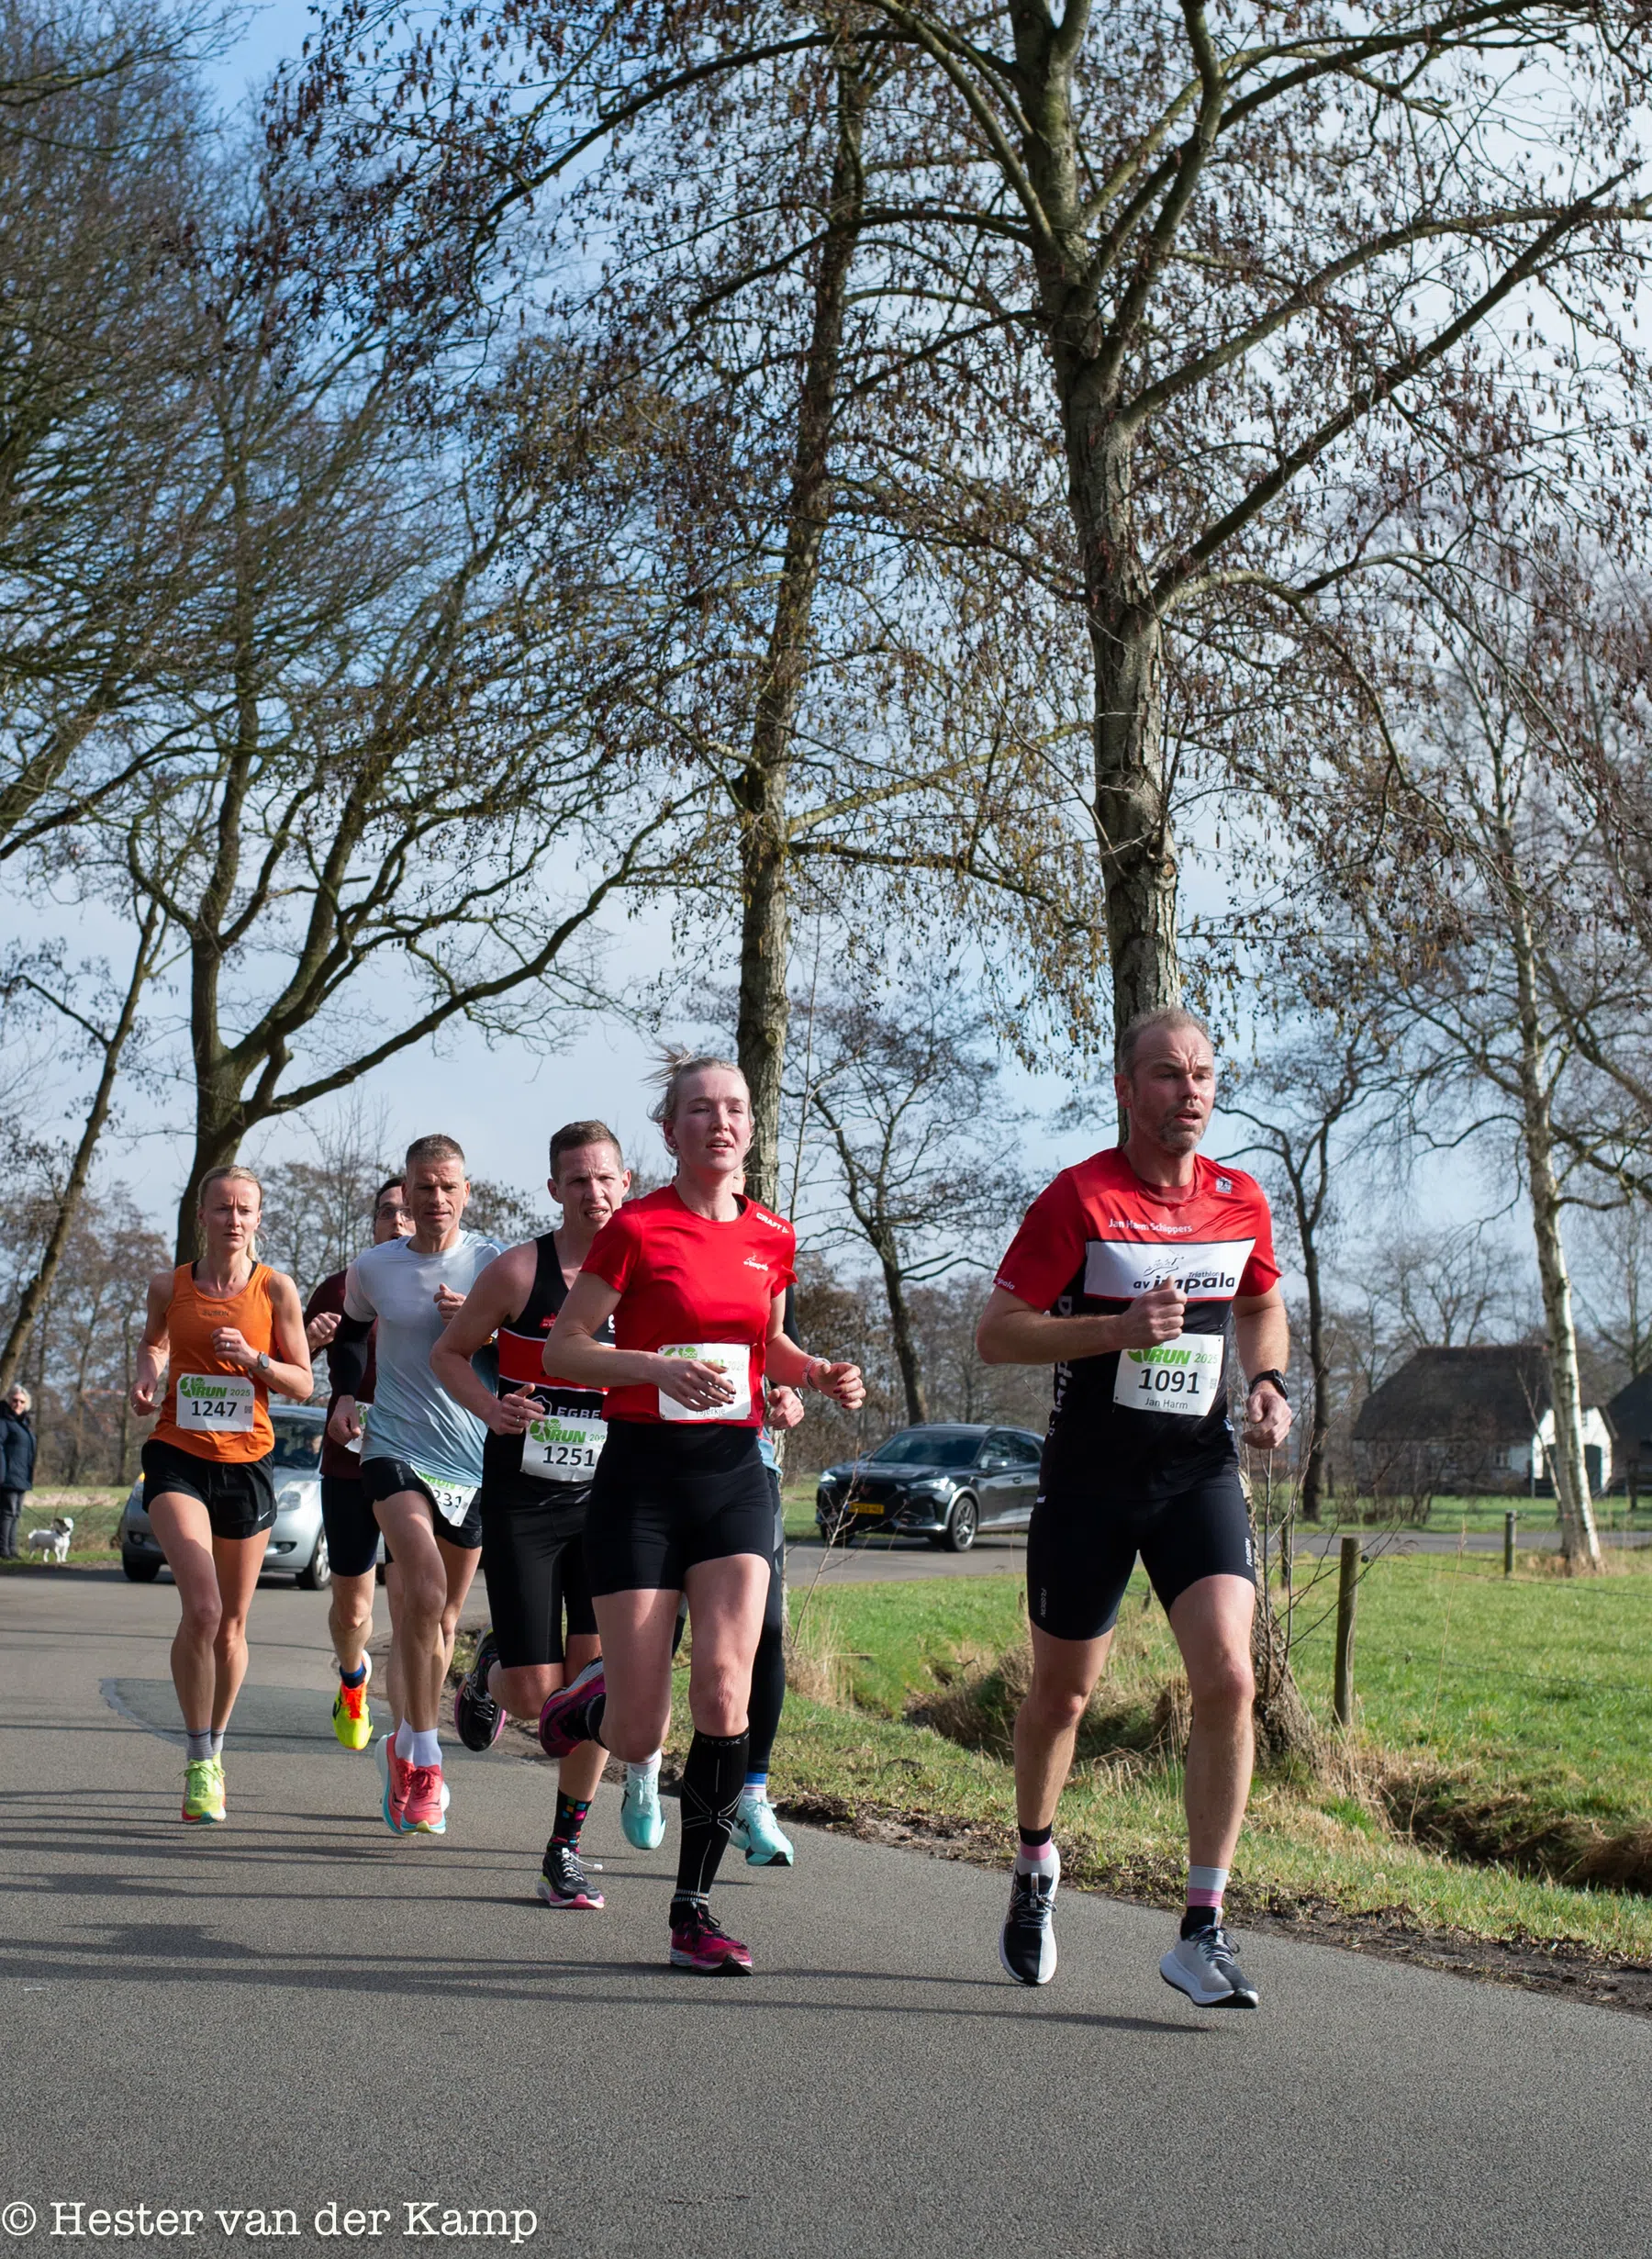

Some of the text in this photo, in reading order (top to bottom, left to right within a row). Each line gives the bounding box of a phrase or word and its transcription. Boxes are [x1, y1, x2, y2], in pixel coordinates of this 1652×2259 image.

[756, 1212, 782, 1230] CRAFT
[1109, 1218, 1124, 1228] Jan
[1150, 1222, 1192, 1235] Schippers
[1133, 1280, 1150, 1289] av
[1194, 1353, 1218, 1364] 2025
[1138, 1368, 1200, 1394] 1091
[195, 1386, 228, 1396] RUN
[191, 1400, 238, 1417] 1247
[1144, 1397, 1189, 1409] Jan Harm
[550, 1429, 586, 1443] RUN
[542, 1446, 596, 1467] 1251
[1245, 1538, 1254, 1567] FUSION
[1040, 1587, 1048, 1618] FUSION
